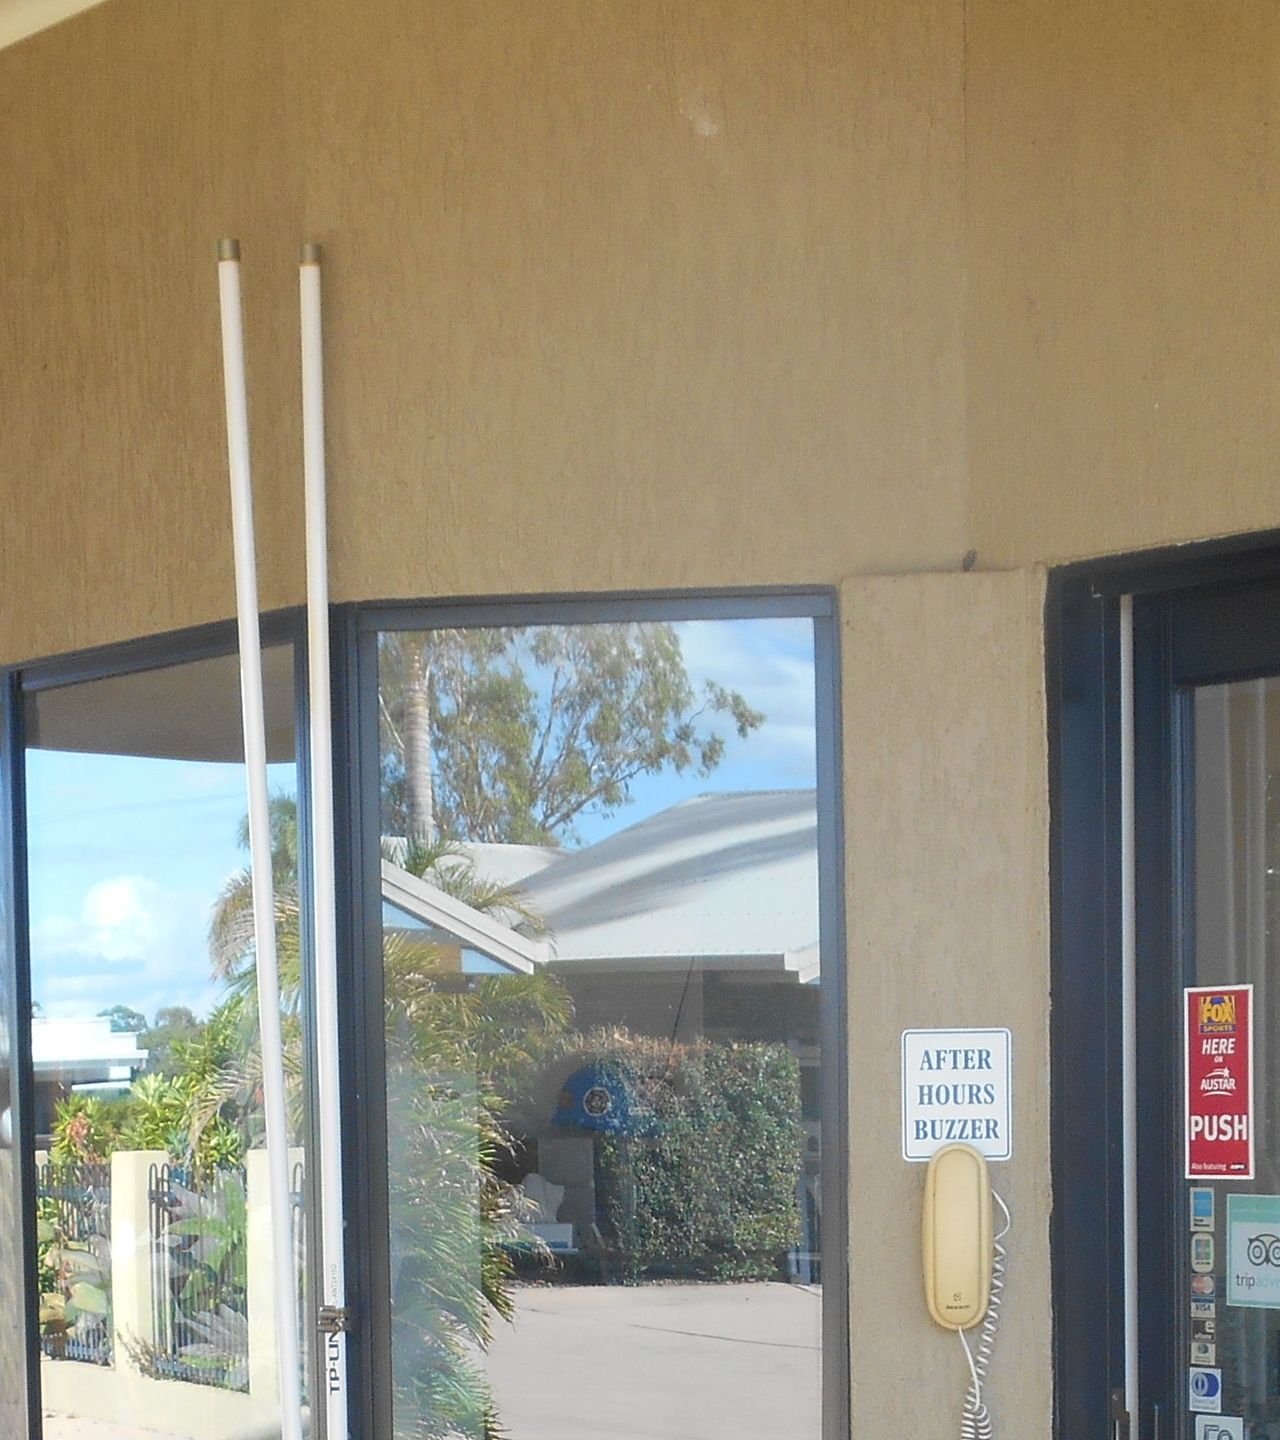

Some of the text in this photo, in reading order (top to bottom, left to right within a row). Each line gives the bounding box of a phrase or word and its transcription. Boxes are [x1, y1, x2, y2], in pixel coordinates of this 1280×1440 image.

[1203, 1002, 1234, 1024] FOX
[1201, 1038, 1237, 1055] HERE
[919, 1048, 993, 1071] AFTER
[917, 1083, 996, 1106] HOURS
[1200, 1078, 1237, 1091] AUSTAR
[913, 1118, 1000, 1141] BUZZER
[1190, 1114, 1248, 1142] PUSH
[1195, 1304, 1211, 1312] VISA
[328, 1331, 341, 1396] TP-LIN
